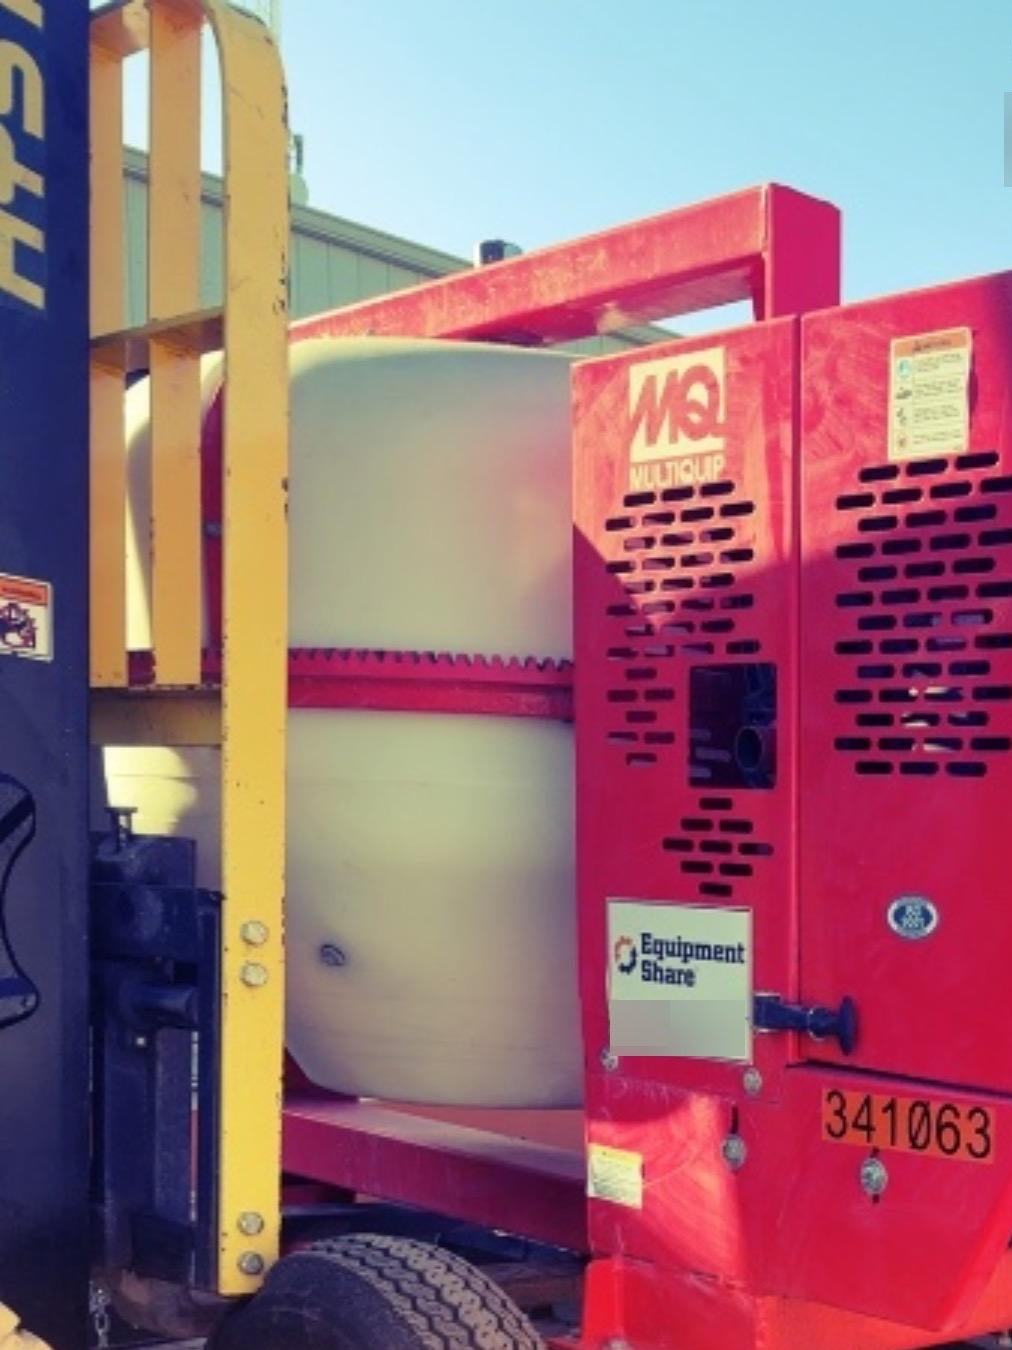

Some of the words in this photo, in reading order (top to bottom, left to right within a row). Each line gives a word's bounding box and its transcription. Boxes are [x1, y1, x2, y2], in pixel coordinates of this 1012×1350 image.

[626, 362, 727, 448] MQ
[629, 452, 726, 491] MULTIQUIP
[641, 932, 745, 964] Equipment
[641, 959, 696, 987] Share
[825, 1090, 992, 1160] 341063
